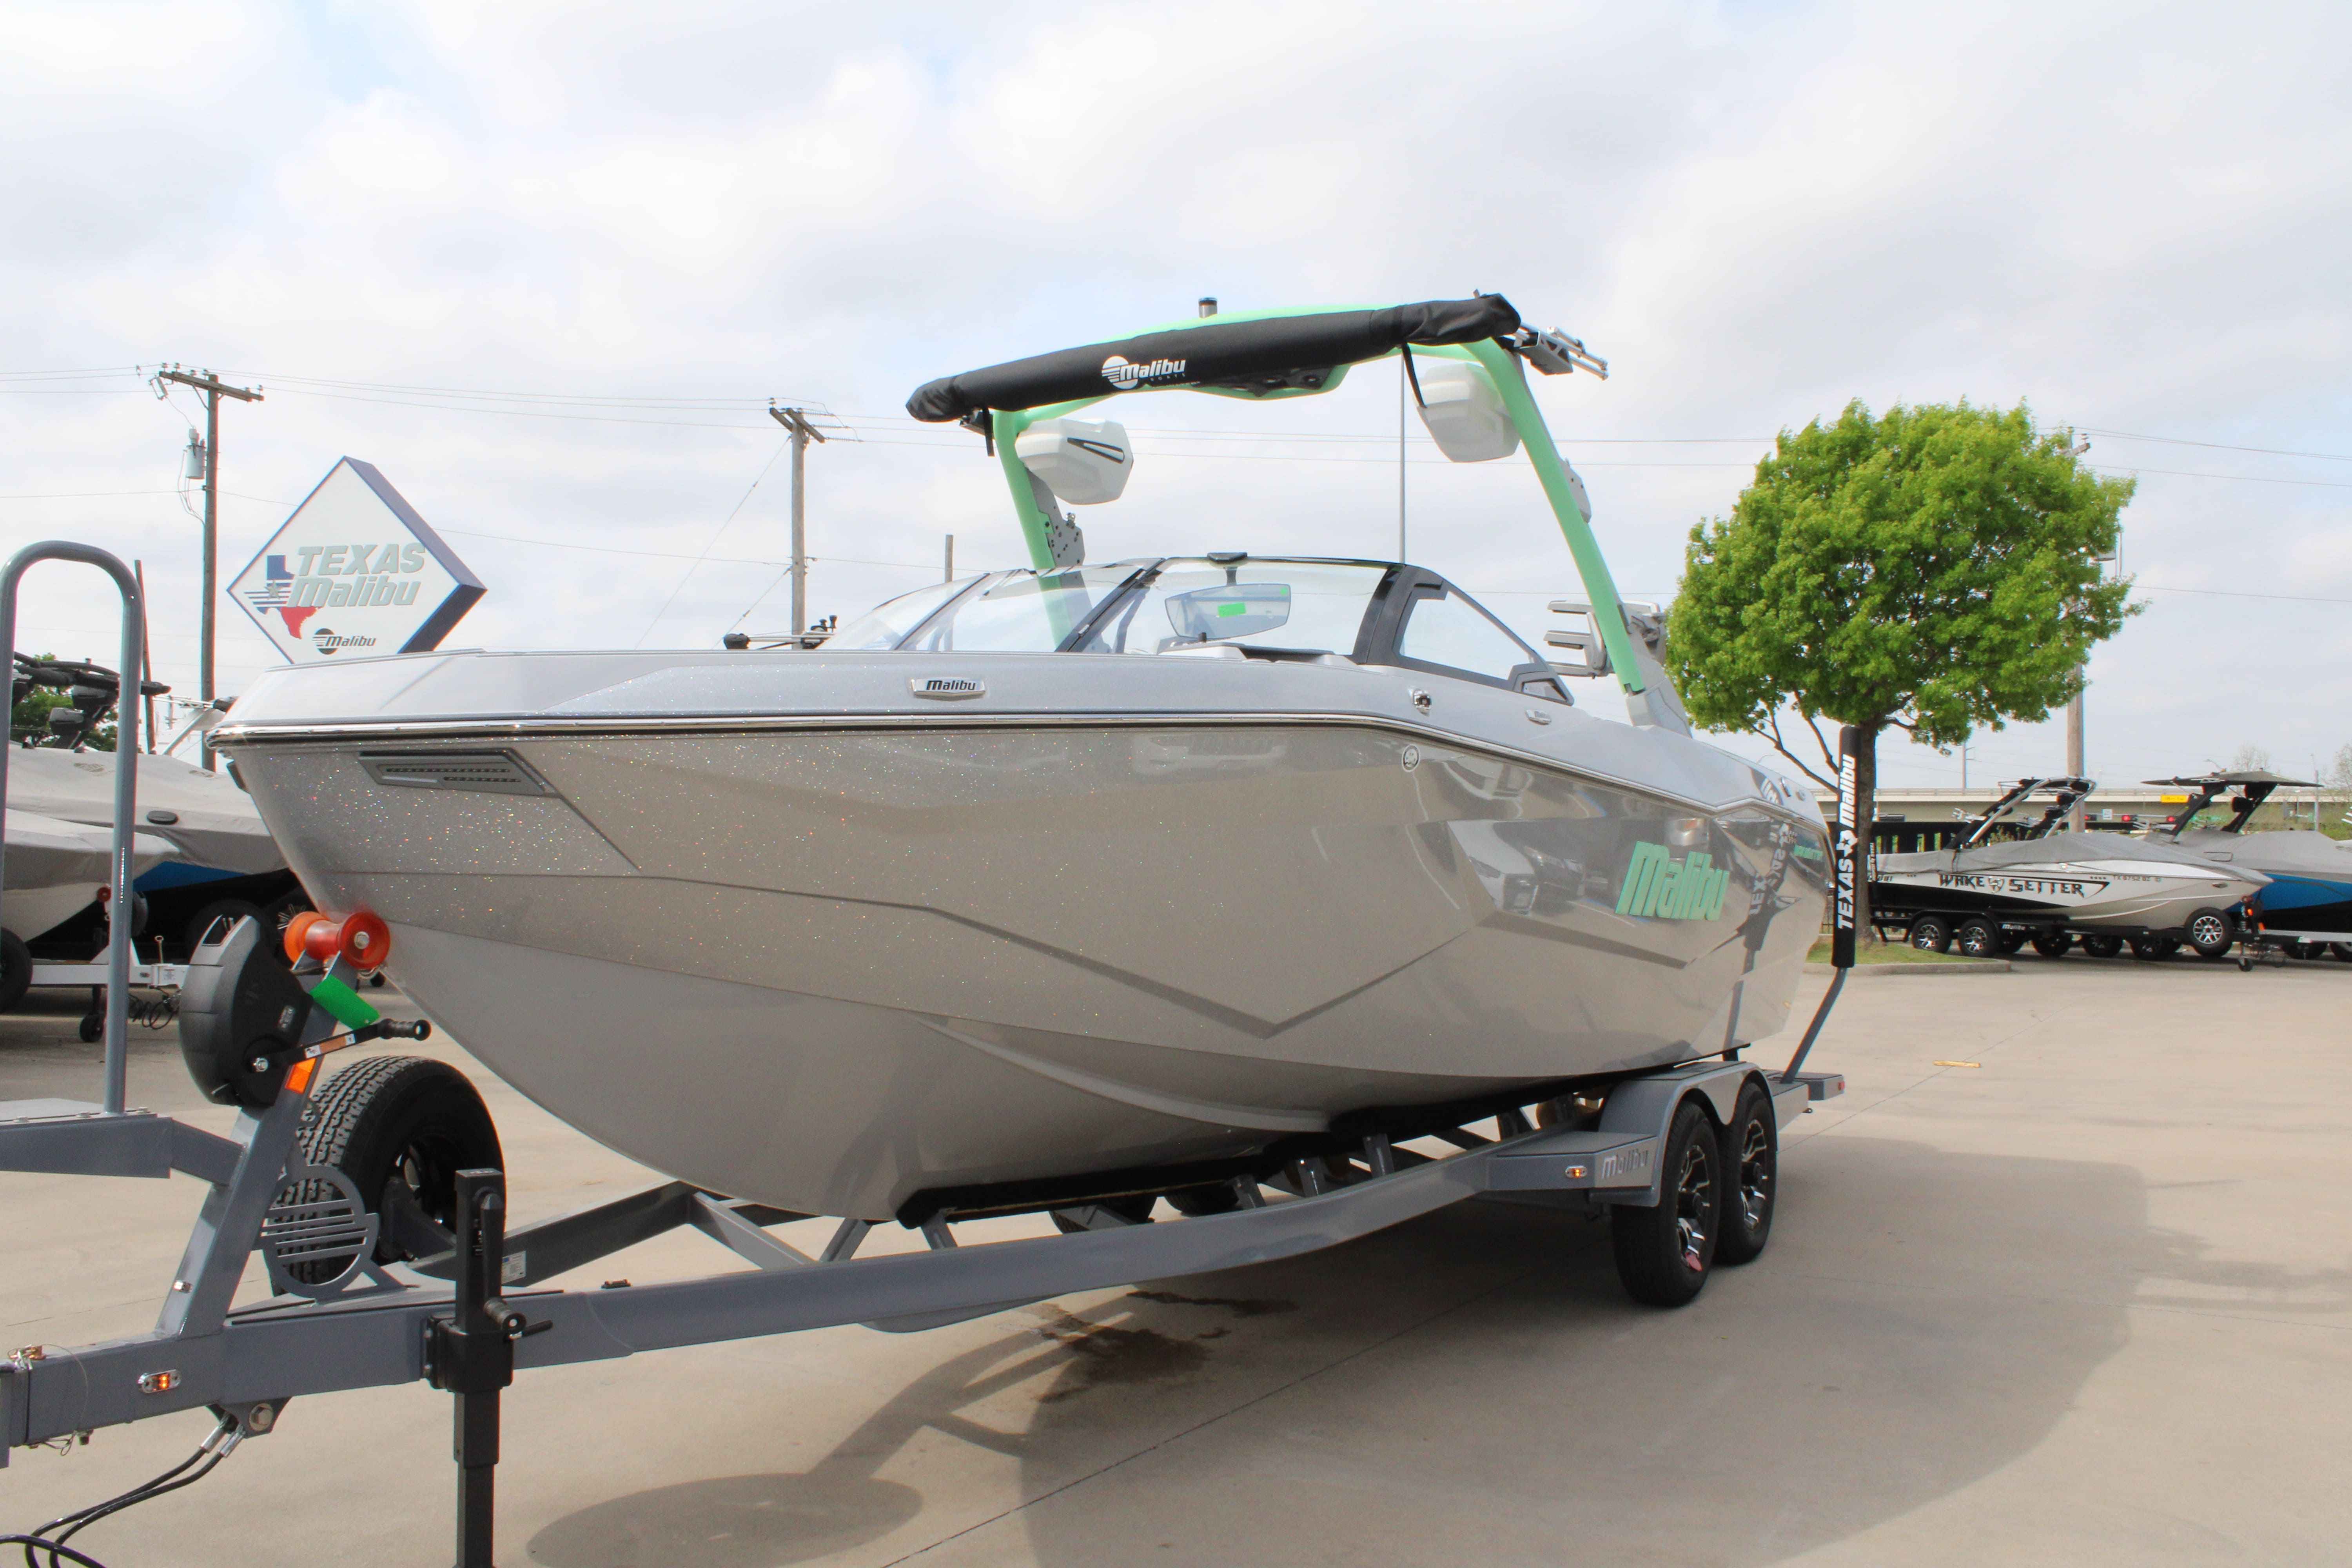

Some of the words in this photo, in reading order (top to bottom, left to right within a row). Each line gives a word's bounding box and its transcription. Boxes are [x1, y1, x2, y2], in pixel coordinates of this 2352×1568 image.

[1120, 359, 1186, 381] Malibu
[298, 543, 426, 576] TEXAS
[286, 575, 421, 608] Malibu
[325, 635, 377, 646] Malibu
[926, 680, 976, 690] Malibu
[1839, 753, 1856, 829] Malibu
[1615, 840, 1730, 921] Malibu
[1837, 858, 1855, 929] TEXAS
[1938, 873, 1985, 890] WAKE
[2009, 878, 2085, 898] SETTER
[1601, 1148, 1648, 1179] Malibu
